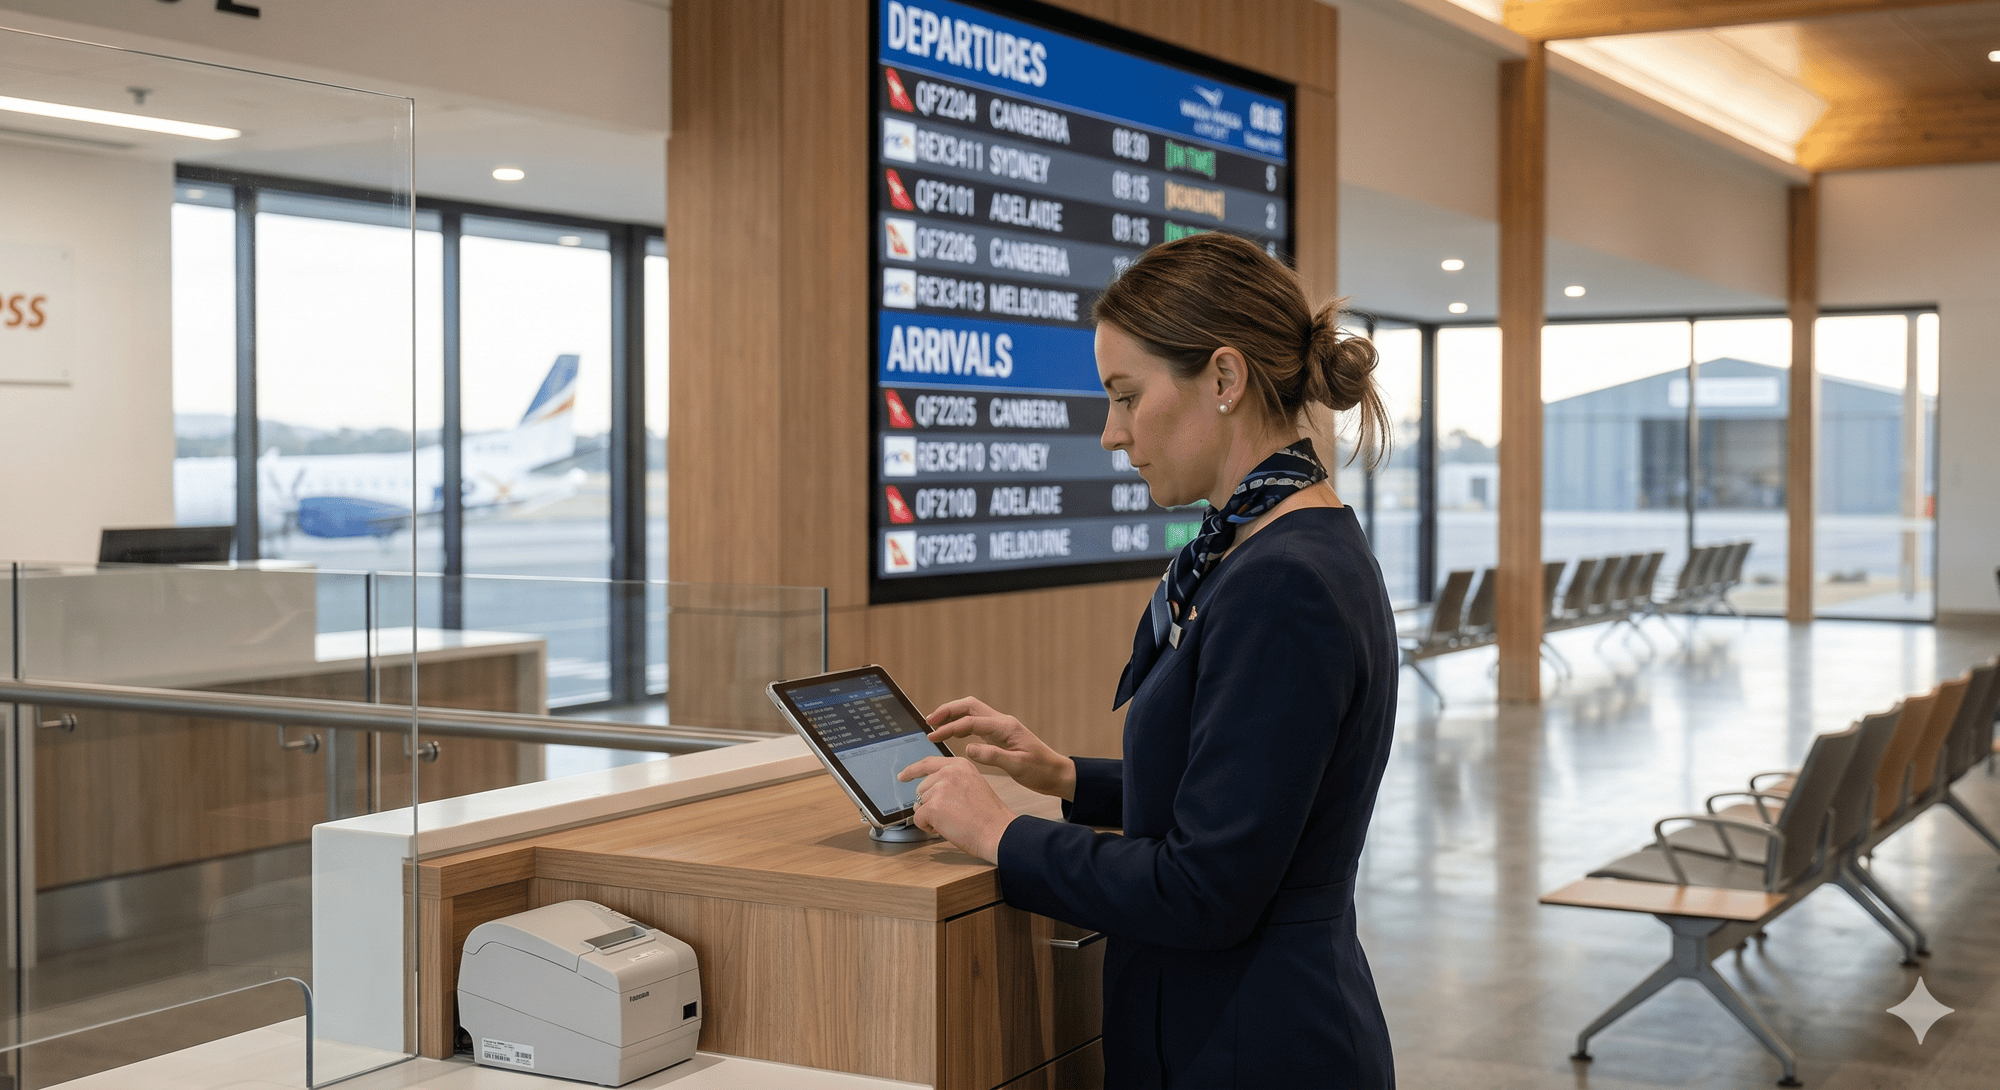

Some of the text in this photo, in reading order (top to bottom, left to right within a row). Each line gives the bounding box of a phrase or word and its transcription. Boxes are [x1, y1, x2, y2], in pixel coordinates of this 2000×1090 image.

[887, 0, 1047, 87] DEPARTURES
[915, 80, 977, 123] QF2204
[989, 98, 1071, 145] CANBERRA
[1265, 164, 1277, 192] 5
[917, 129, 984, 172] REX3411
[989, 144, 1051, 184] SYDNEY
[1265, 202, 1277, 230] 2
[915, 178, 975, 217] QF2101
[989, 192, 1063, 233] ADELAIDE
[917, 227, 977, 265] QF2206
[989, 237, 1071, 277] CANBERRA
[917, 274, 1080, 322] REX3413 MELBOURNE
[886, 325, 1013, 378] ARRIVALS
[915, 395, 1070, 429] QF2205 CANBERRA
[989, 442, 1051, 472] SYDNEY
[989, 486, 1063, 517] ADELAIDE
[989, 528, 1072, 561] MELBOURNE
